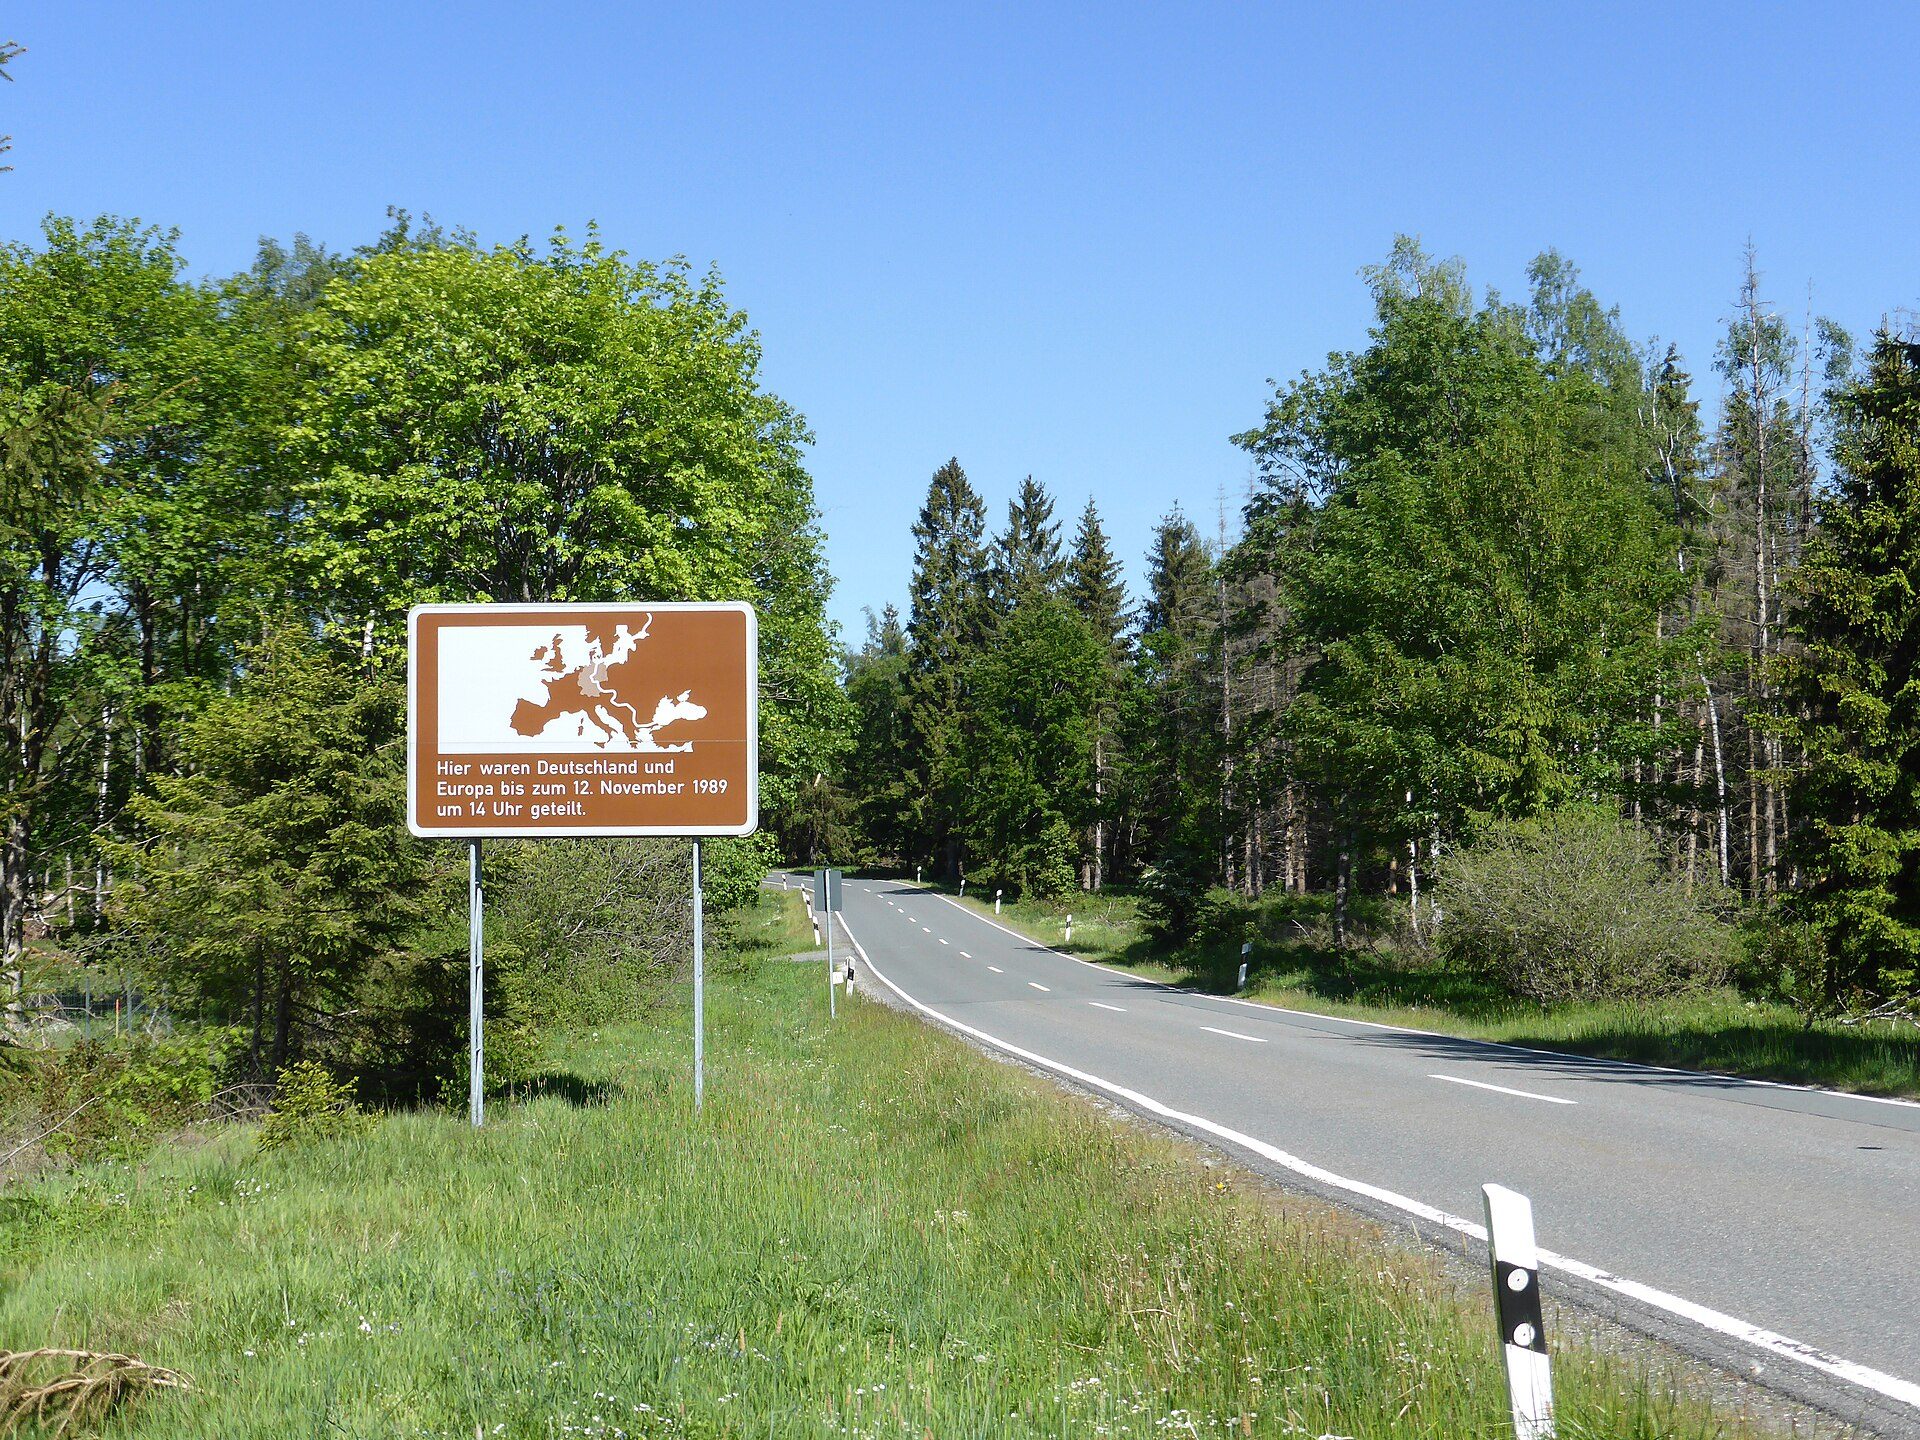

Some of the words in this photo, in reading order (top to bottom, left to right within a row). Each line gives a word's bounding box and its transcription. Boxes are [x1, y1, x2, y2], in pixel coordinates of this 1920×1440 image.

[437, 761, 471, 775] Hier
[480, 764, 530, 775] waren
[538, 760, 637, 774] Deutschland
[645, 760, 674, 773] und
[437, 781, 493, 799] Europa
[501, 781, 524, 795] bis
[532, 784, 565, 795] zum
[574, 780, 593, 794] 12.
[601, 780, 685, 794] November
[693, 779, 727, 794] 1989
[437, 806, 462, 816] um
[470, 802, 485, 816] 14
[493, 802, 523, 816] Uhr
[531, 801, 586, 819] geteilt.
